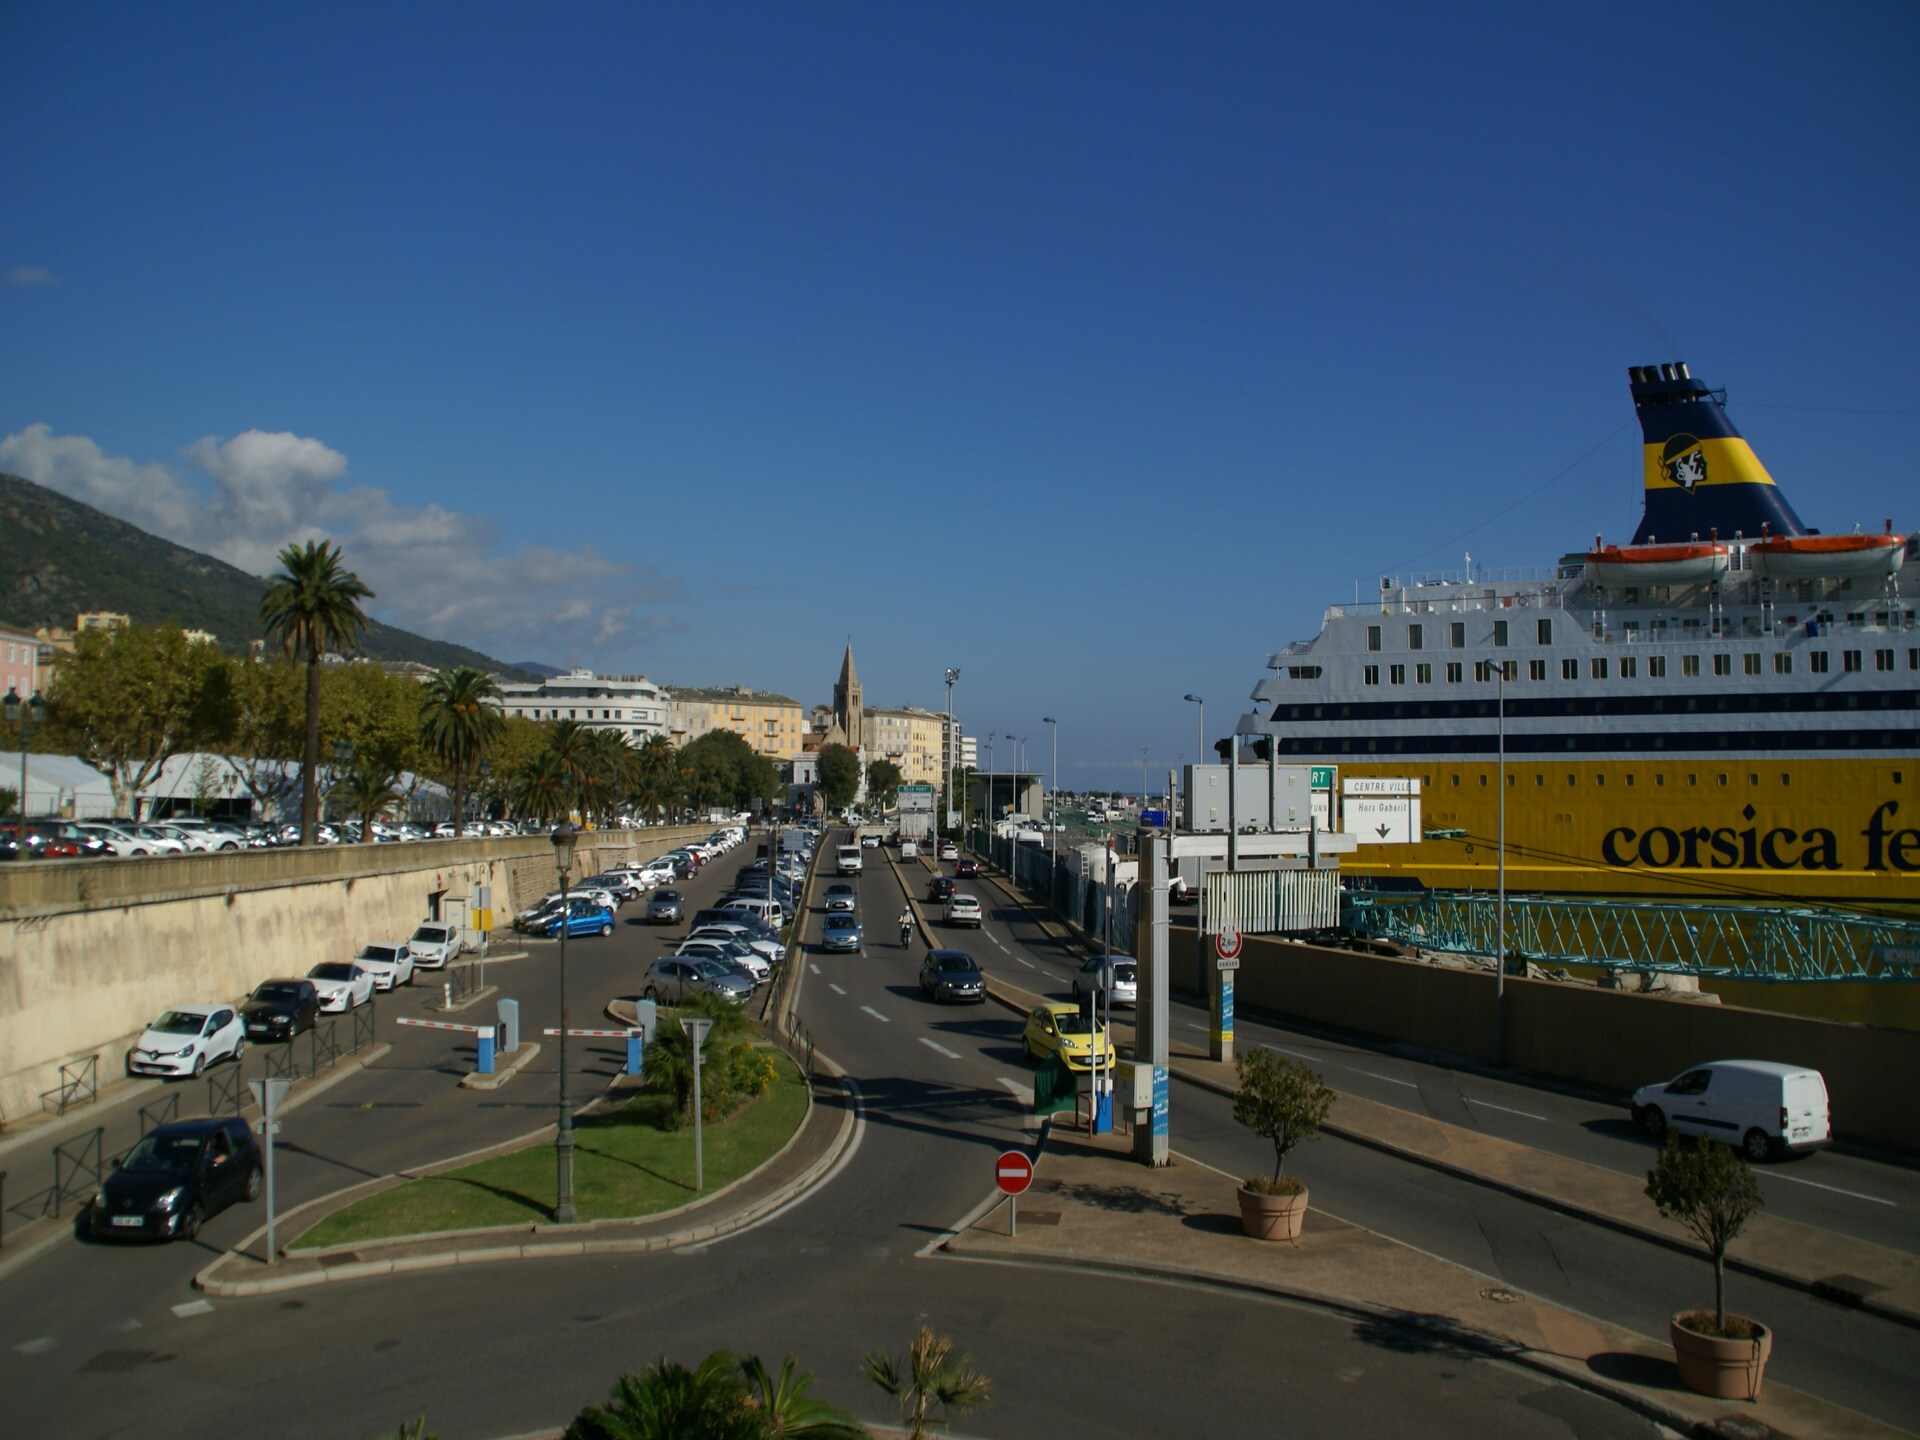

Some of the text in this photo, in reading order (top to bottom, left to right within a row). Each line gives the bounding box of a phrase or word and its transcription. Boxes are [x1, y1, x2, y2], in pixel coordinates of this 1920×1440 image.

[1354, 782, 1410, 791] CENTRE VILLE
[1359, 803, 1407, 812] Hors Gabarit
[1602, 800, 1920, 872] corsica fe
